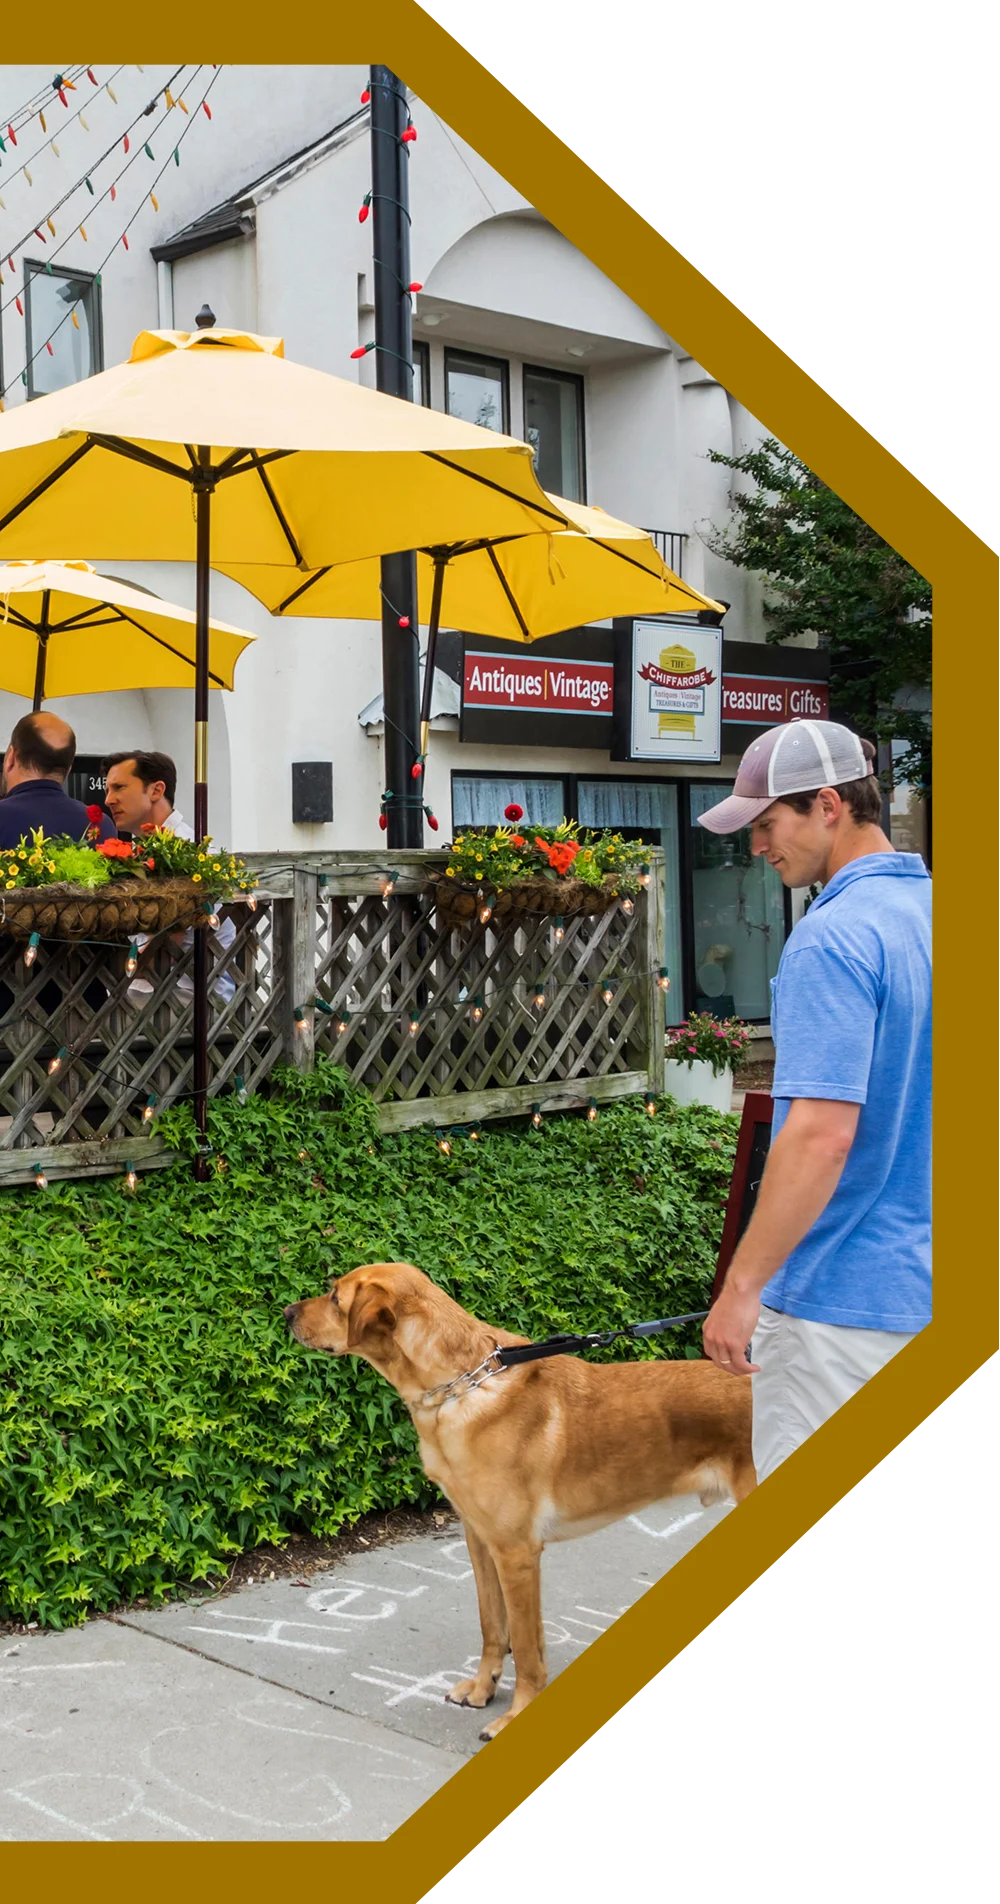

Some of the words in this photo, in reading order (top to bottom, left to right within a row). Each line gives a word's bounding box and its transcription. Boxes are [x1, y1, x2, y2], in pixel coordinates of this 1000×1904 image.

[670, 659, 686, 669] THE
[648, 666, 706, 688] CHIFFAROBE
[469, 665, 542, 703] Antiques
[549, 671, 609, 707] Vintage
[653, 690, 678, 699] Antiques
[681, 691, 702, 701] Vintage
[656, 699, 681, 708] TREASURES
[721, 685, 783, 712] reasures
[790, 688, 821, 714] Gifts
